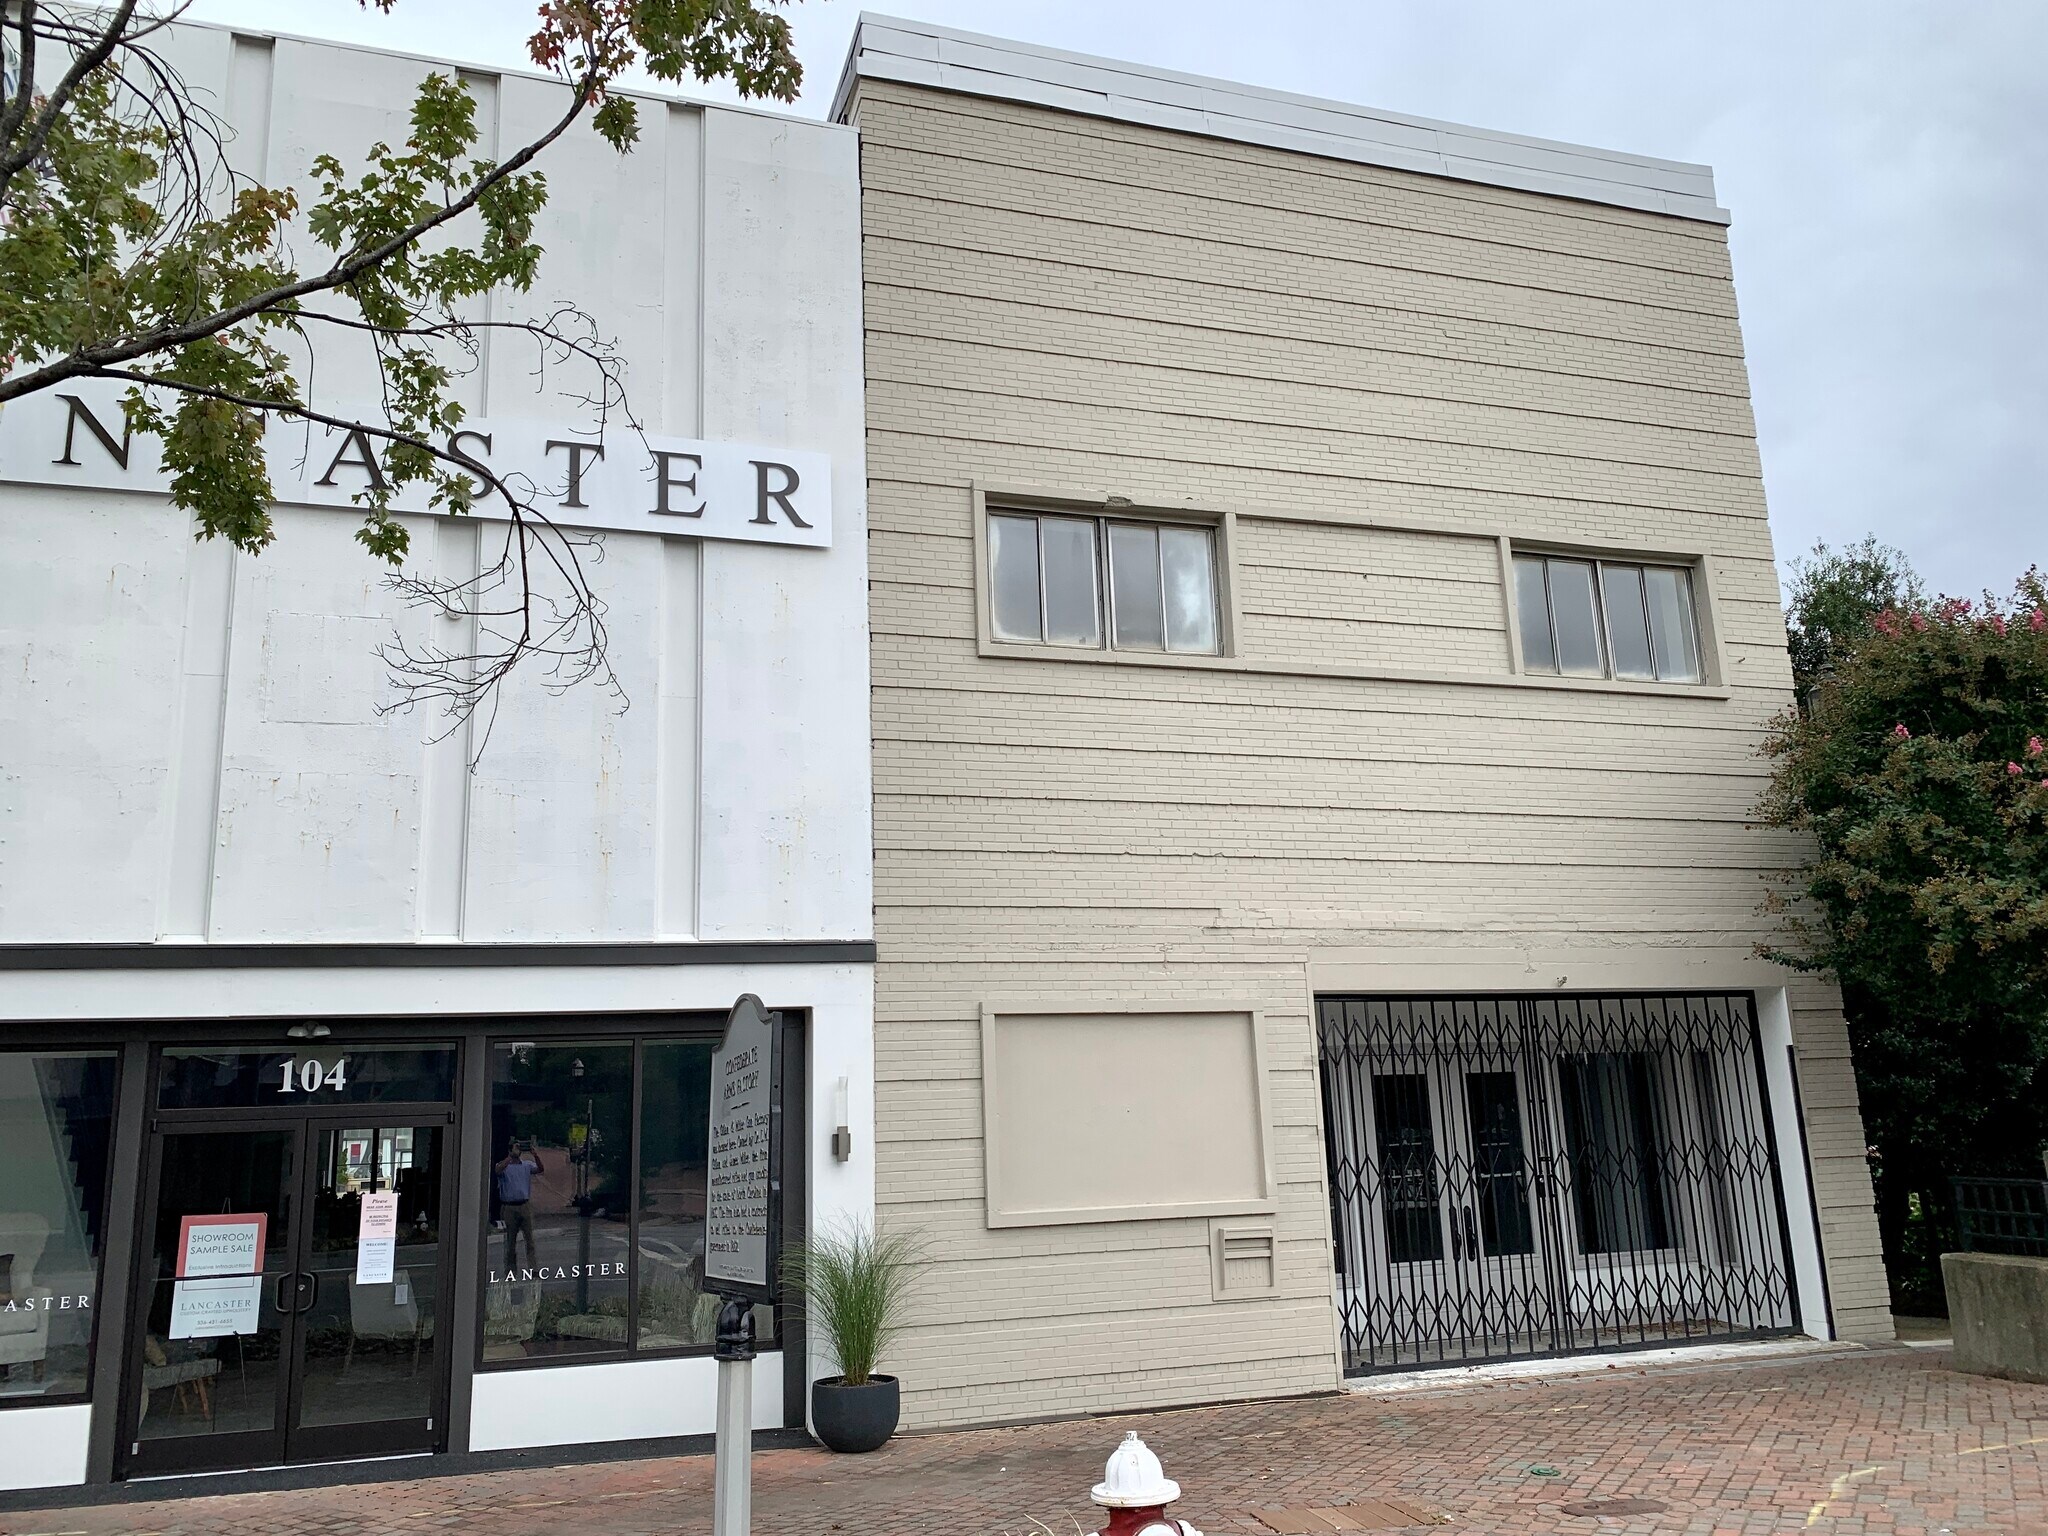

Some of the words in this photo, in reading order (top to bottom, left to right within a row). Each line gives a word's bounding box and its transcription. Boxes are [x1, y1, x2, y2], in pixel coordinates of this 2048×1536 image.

[51, 393, 813, 528] NASTER
[277, 1058, 347, 1093] 104
[192, 1233, 254, 1243] SHOWROOM
[190, 1245, 228, 1254] SAMPLE
[231, 1244, 253, 1253] SALE
[489, 1262, 625, 1283] LANCASTER
[4, 1296, 90, 1312] ASTER
[181, 1300, 251, 1311] LANCASTER
